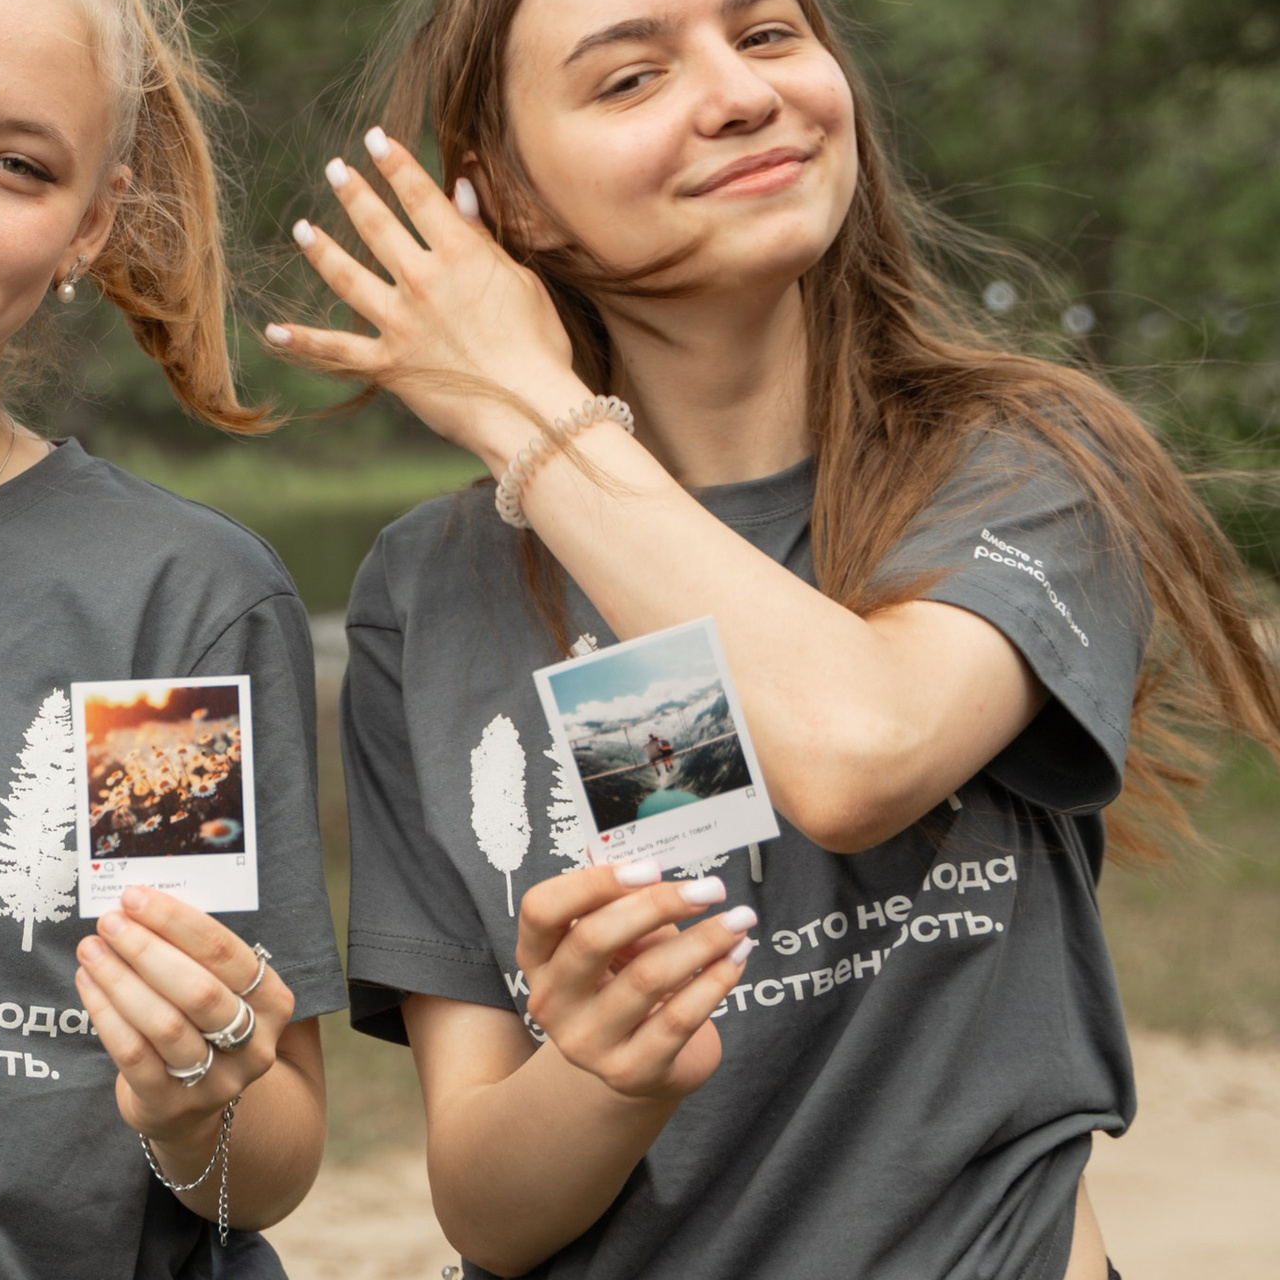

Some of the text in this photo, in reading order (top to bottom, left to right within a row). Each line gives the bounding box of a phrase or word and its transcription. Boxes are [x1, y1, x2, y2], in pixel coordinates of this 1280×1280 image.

[771, 855, 1018, 956] это не ода
